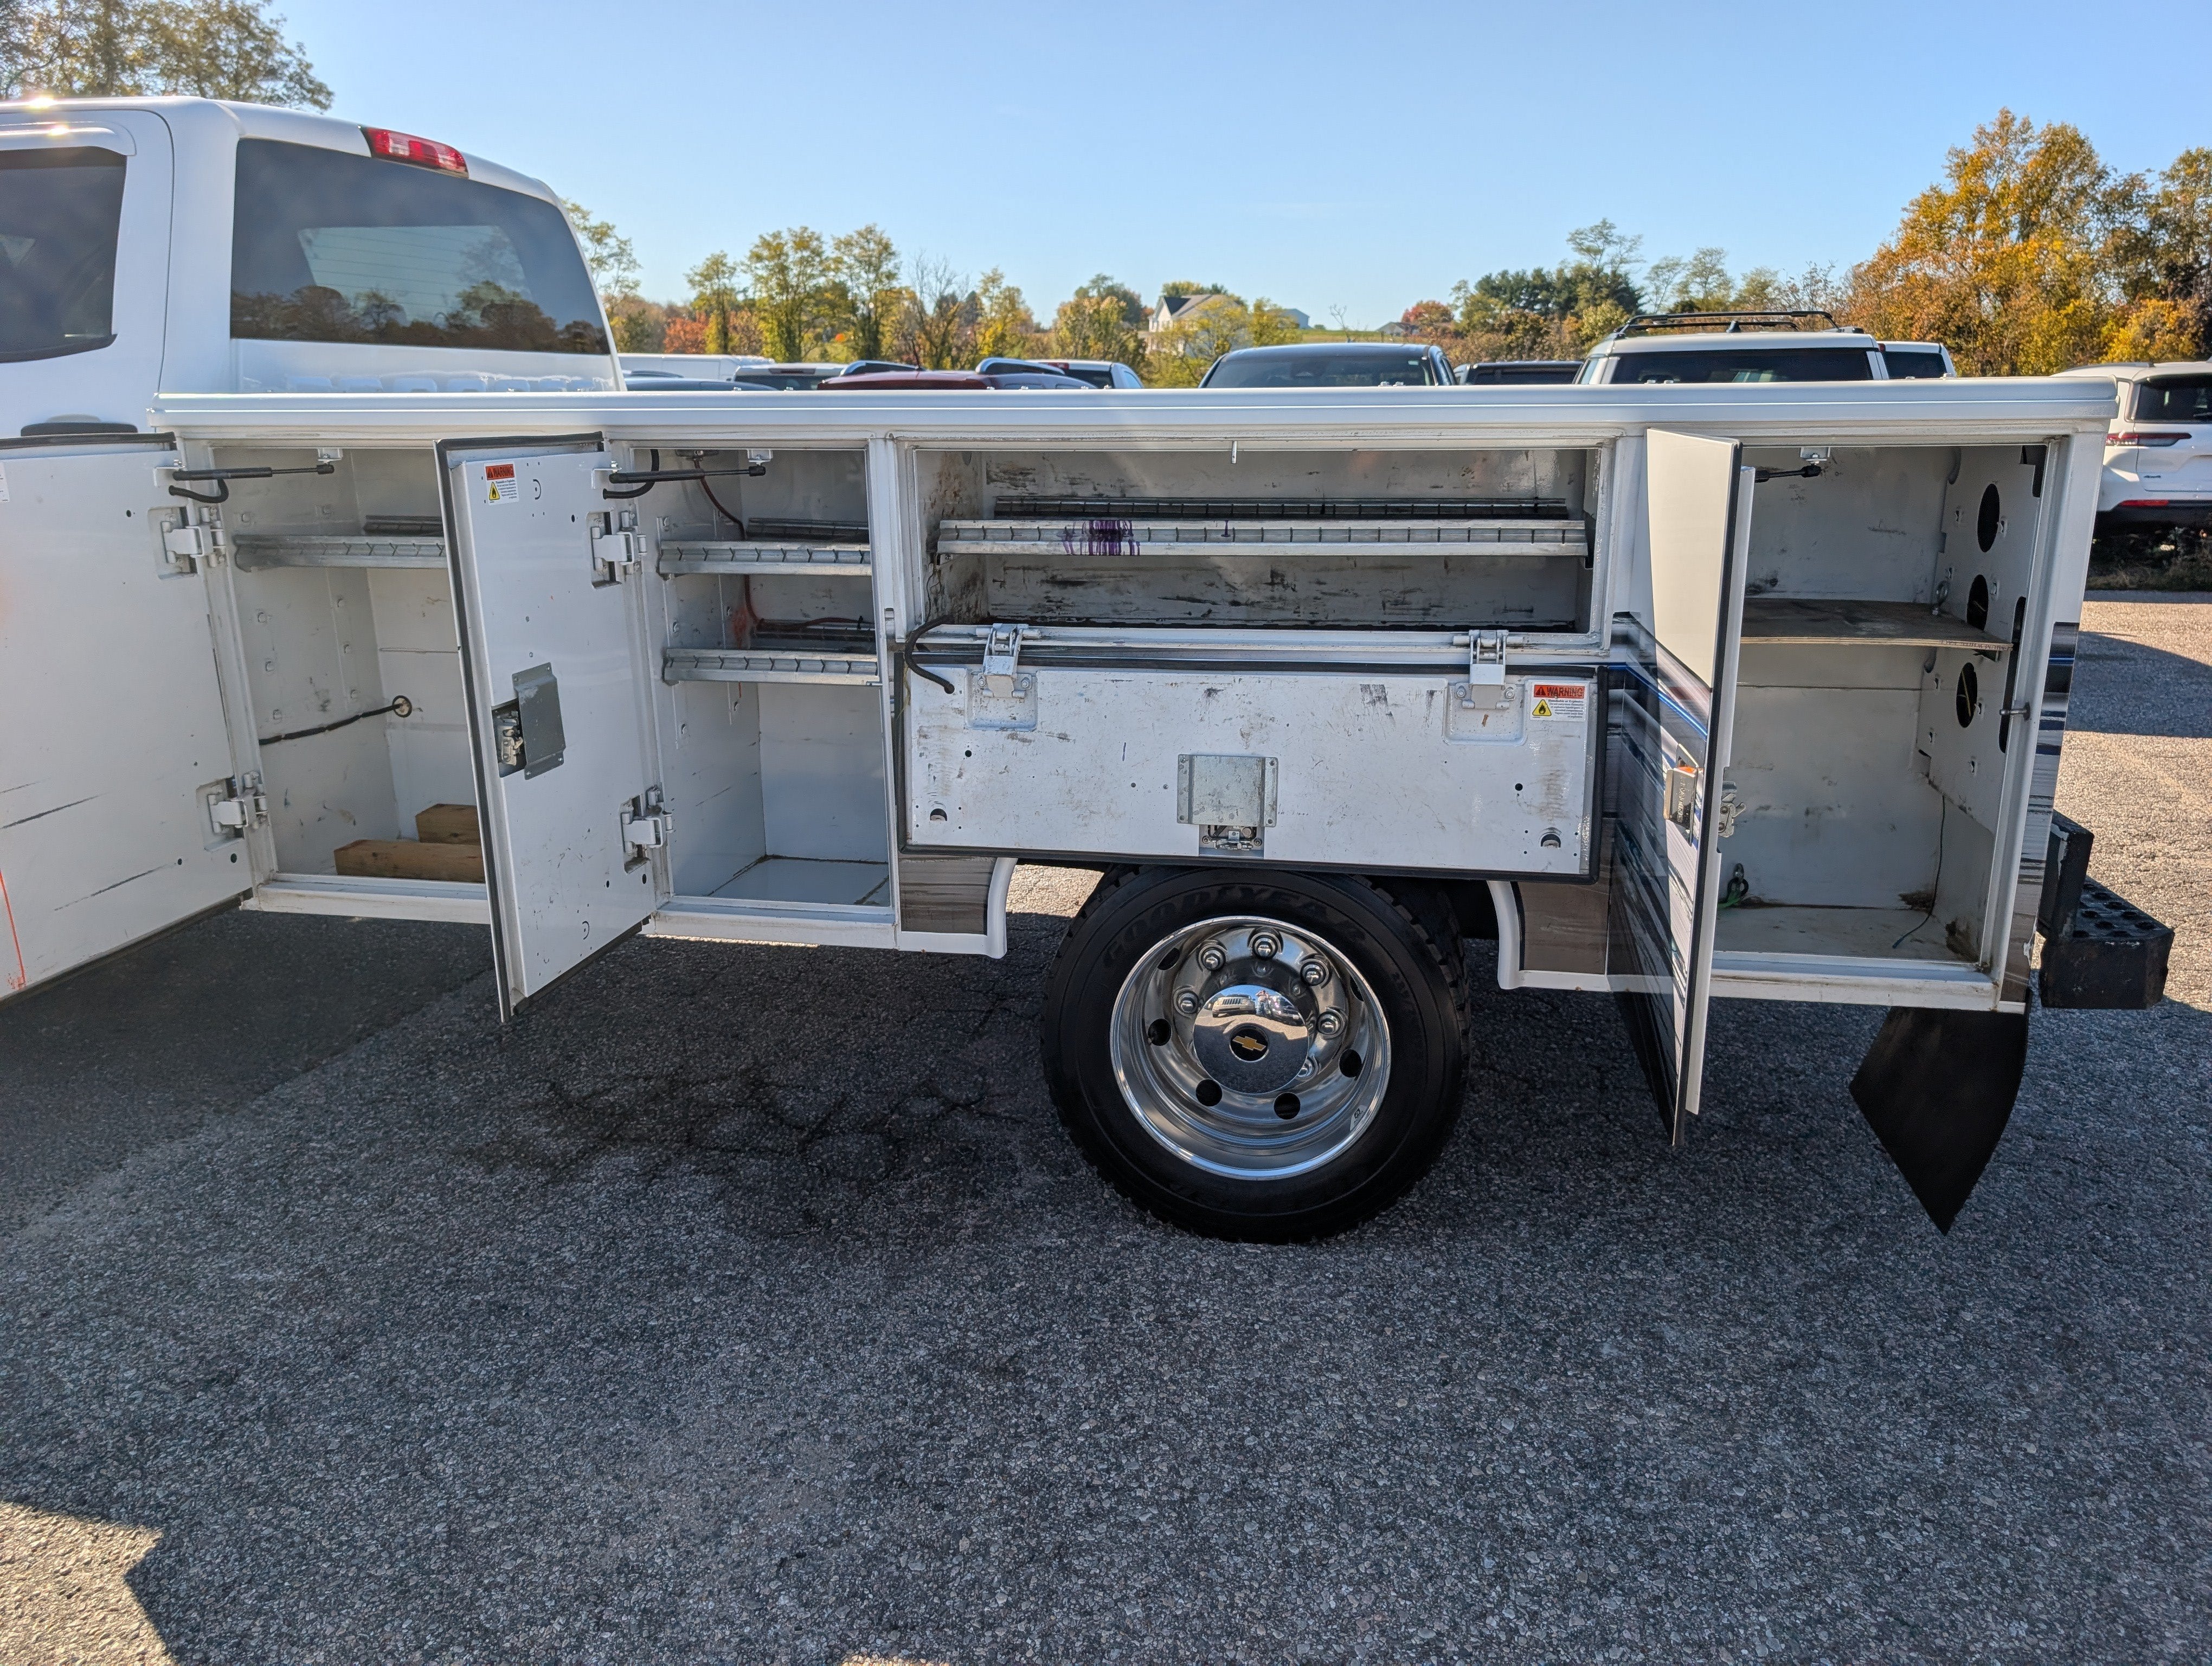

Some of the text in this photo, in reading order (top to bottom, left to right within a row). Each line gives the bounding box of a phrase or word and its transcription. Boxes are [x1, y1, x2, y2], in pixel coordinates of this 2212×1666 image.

[493, 466, 513, 477] WARNING
[1547, 687, 1583, 697] WARNING
[1104, 885, 1366, 967] GOODYEAR
